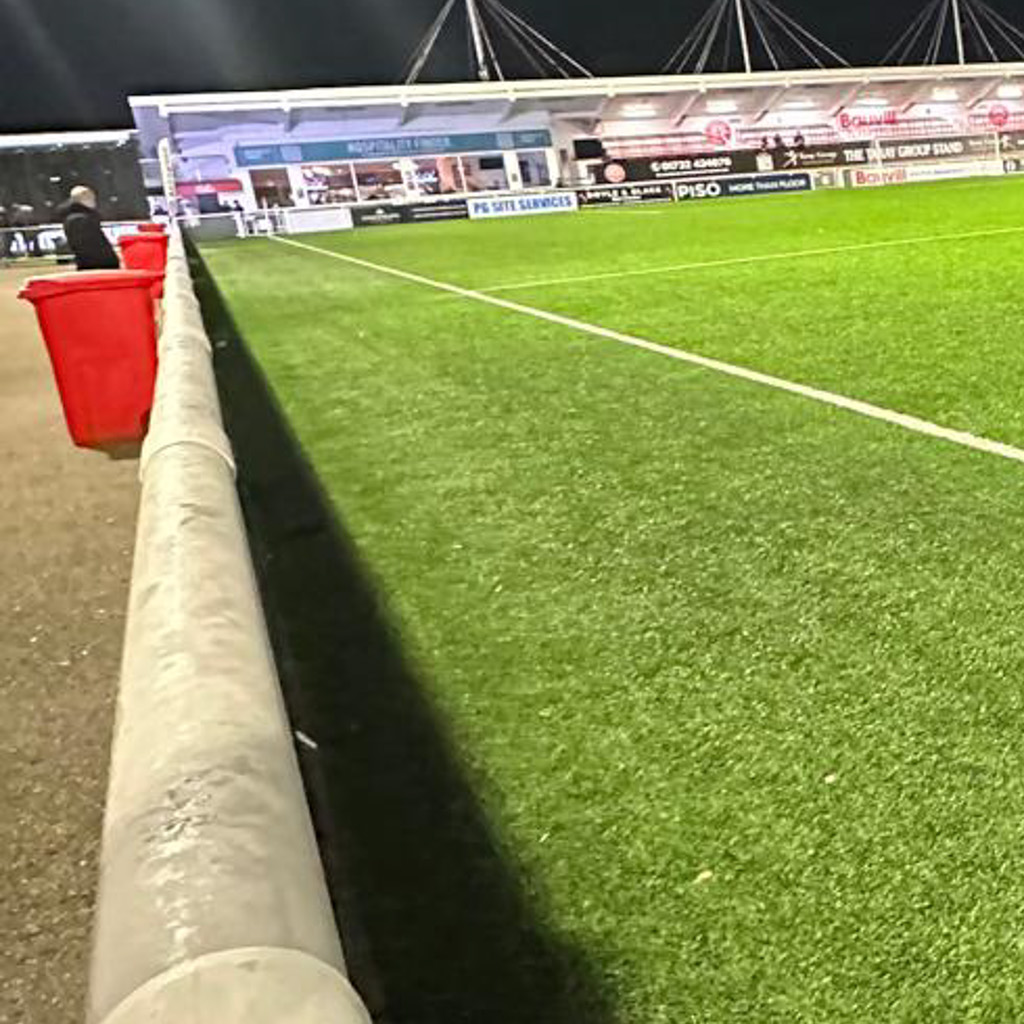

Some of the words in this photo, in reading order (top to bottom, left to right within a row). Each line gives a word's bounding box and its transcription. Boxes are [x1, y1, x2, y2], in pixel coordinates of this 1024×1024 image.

[844, 148, 865, 162] THE
[679, 182, 721, 198] PISO
[473, 202, 490, 214] PG
[492, 199, 515, 212] SITE
[518, 195, 572, 210] SERVICES
